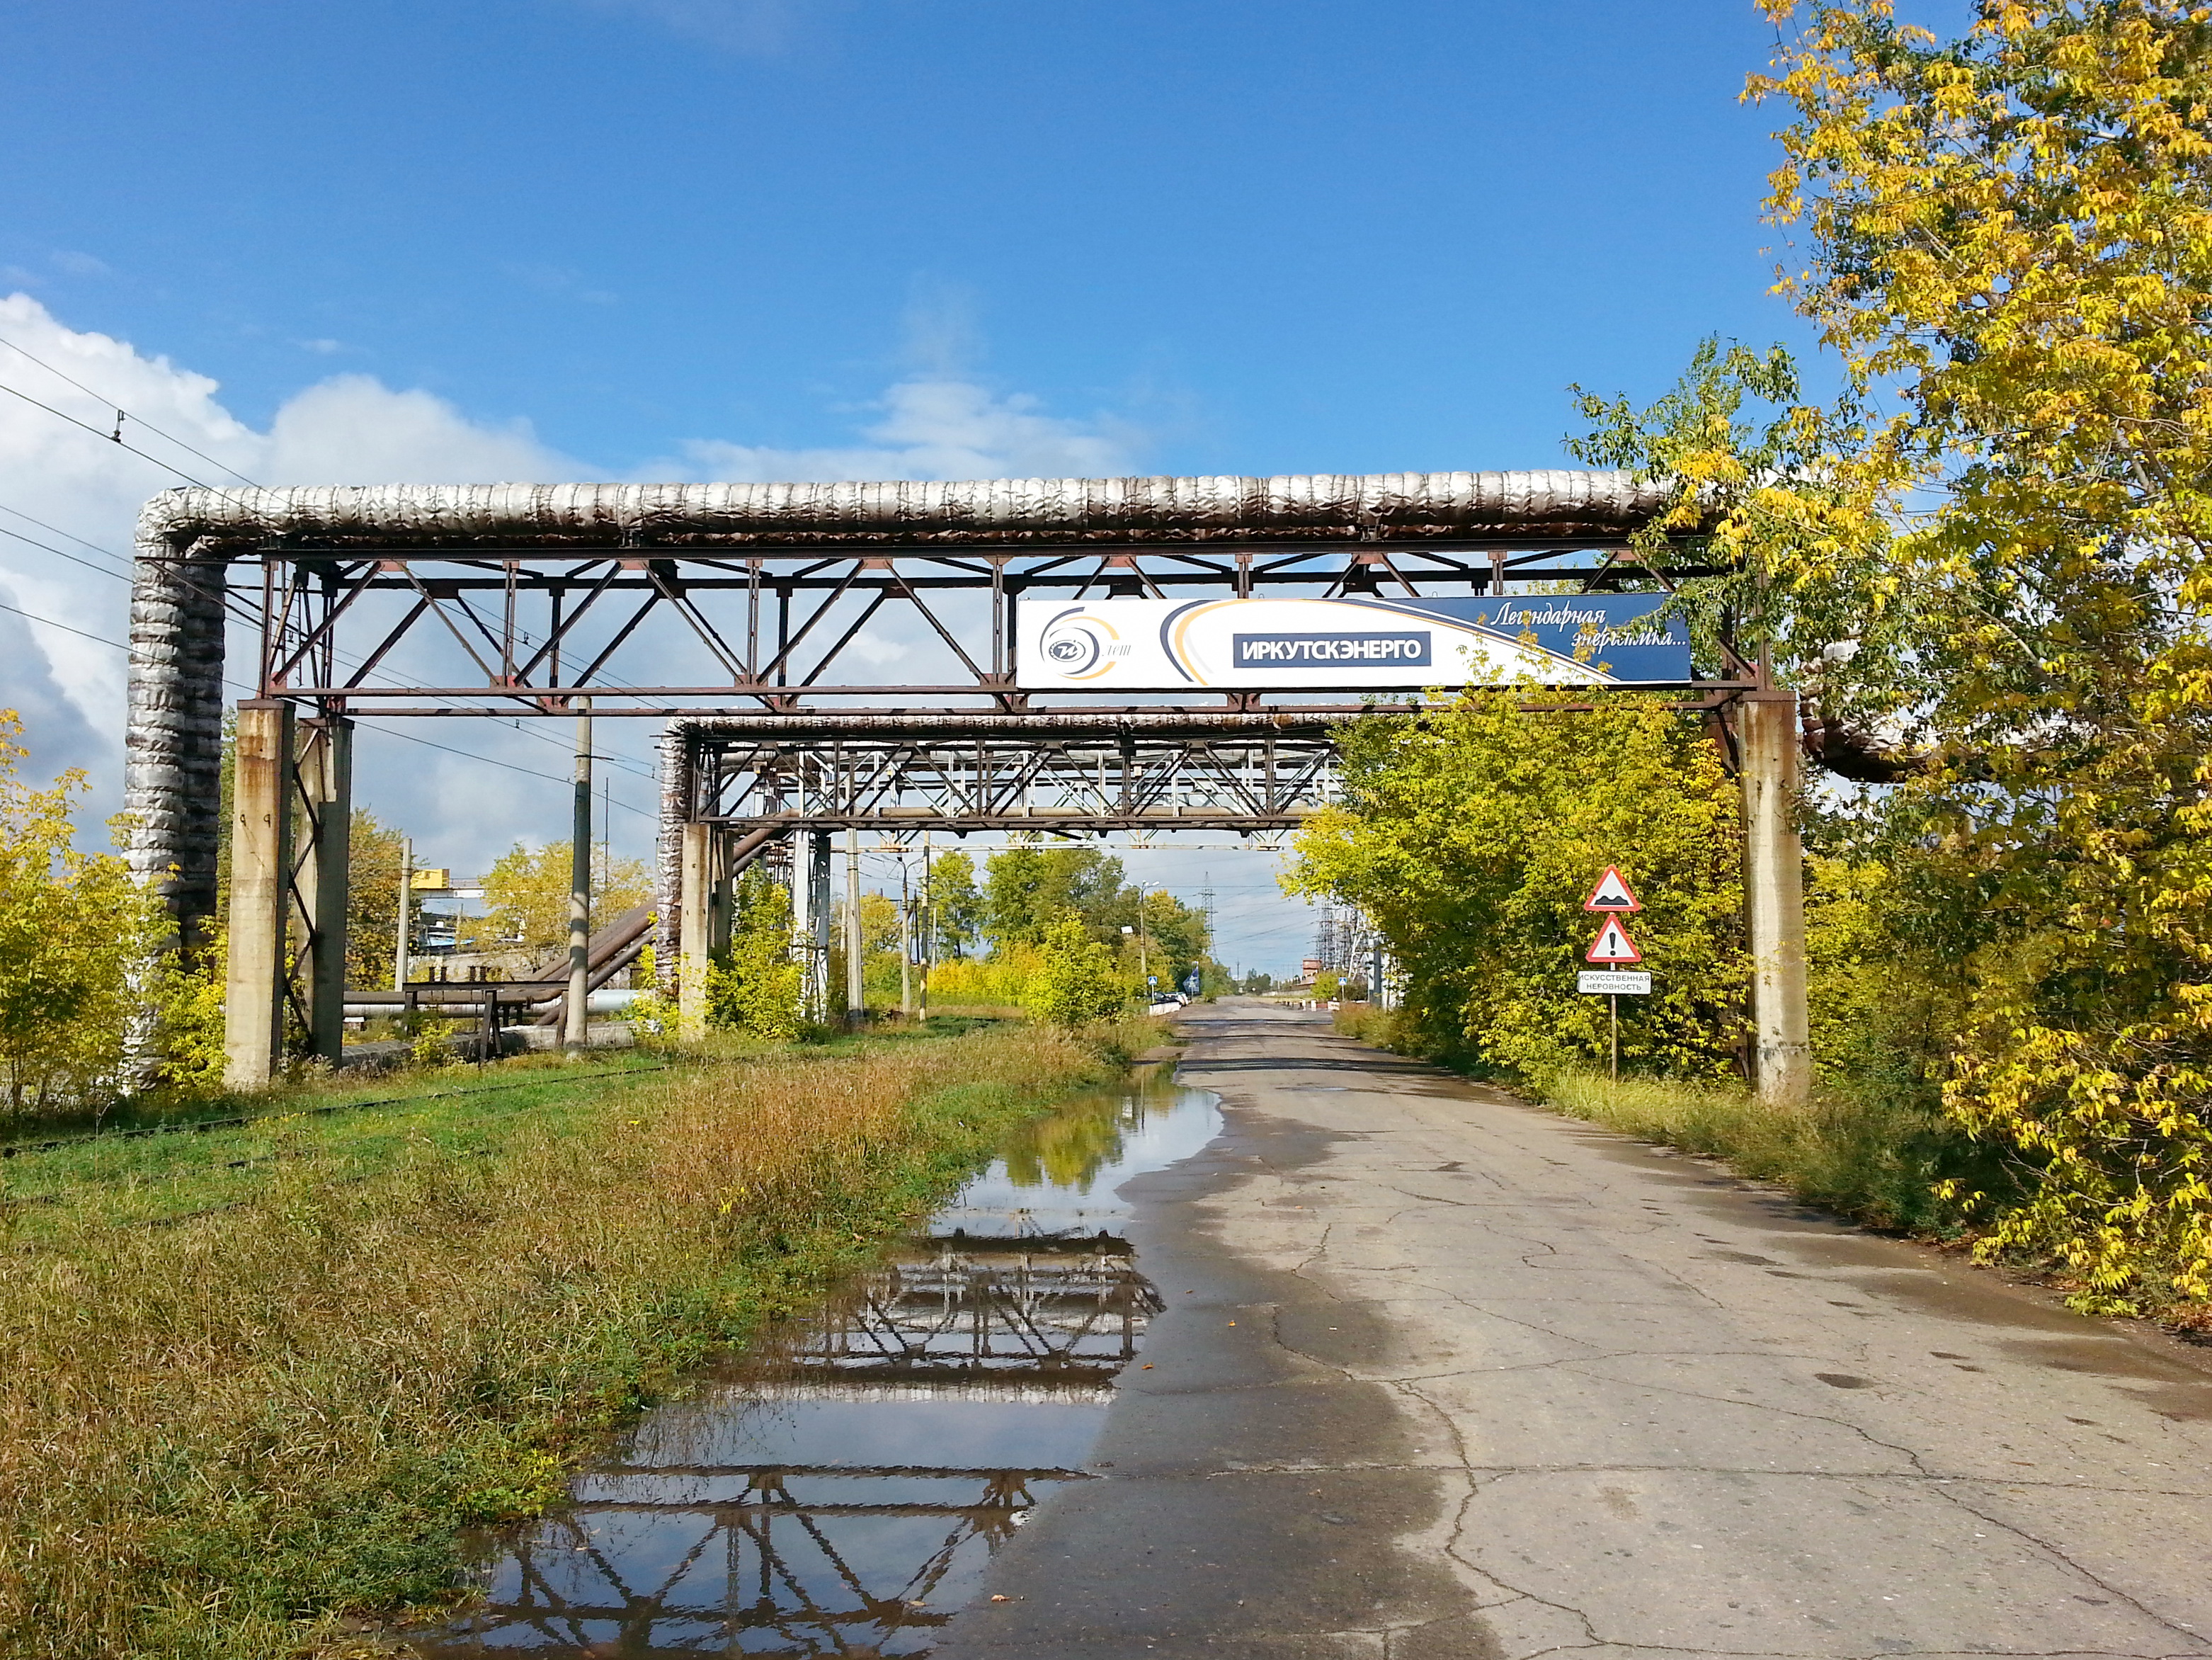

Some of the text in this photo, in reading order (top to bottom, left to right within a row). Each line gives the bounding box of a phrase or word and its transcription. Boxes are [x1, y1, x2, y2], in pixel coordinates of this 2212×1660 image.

[1490, 600, 1607, 633] Легндарная
[1242, 639, 1422, 660] ИРКУТСКЭНЕРГО
[1578, 974, 1650, 982] ИСКУССТВЕННАЯ
